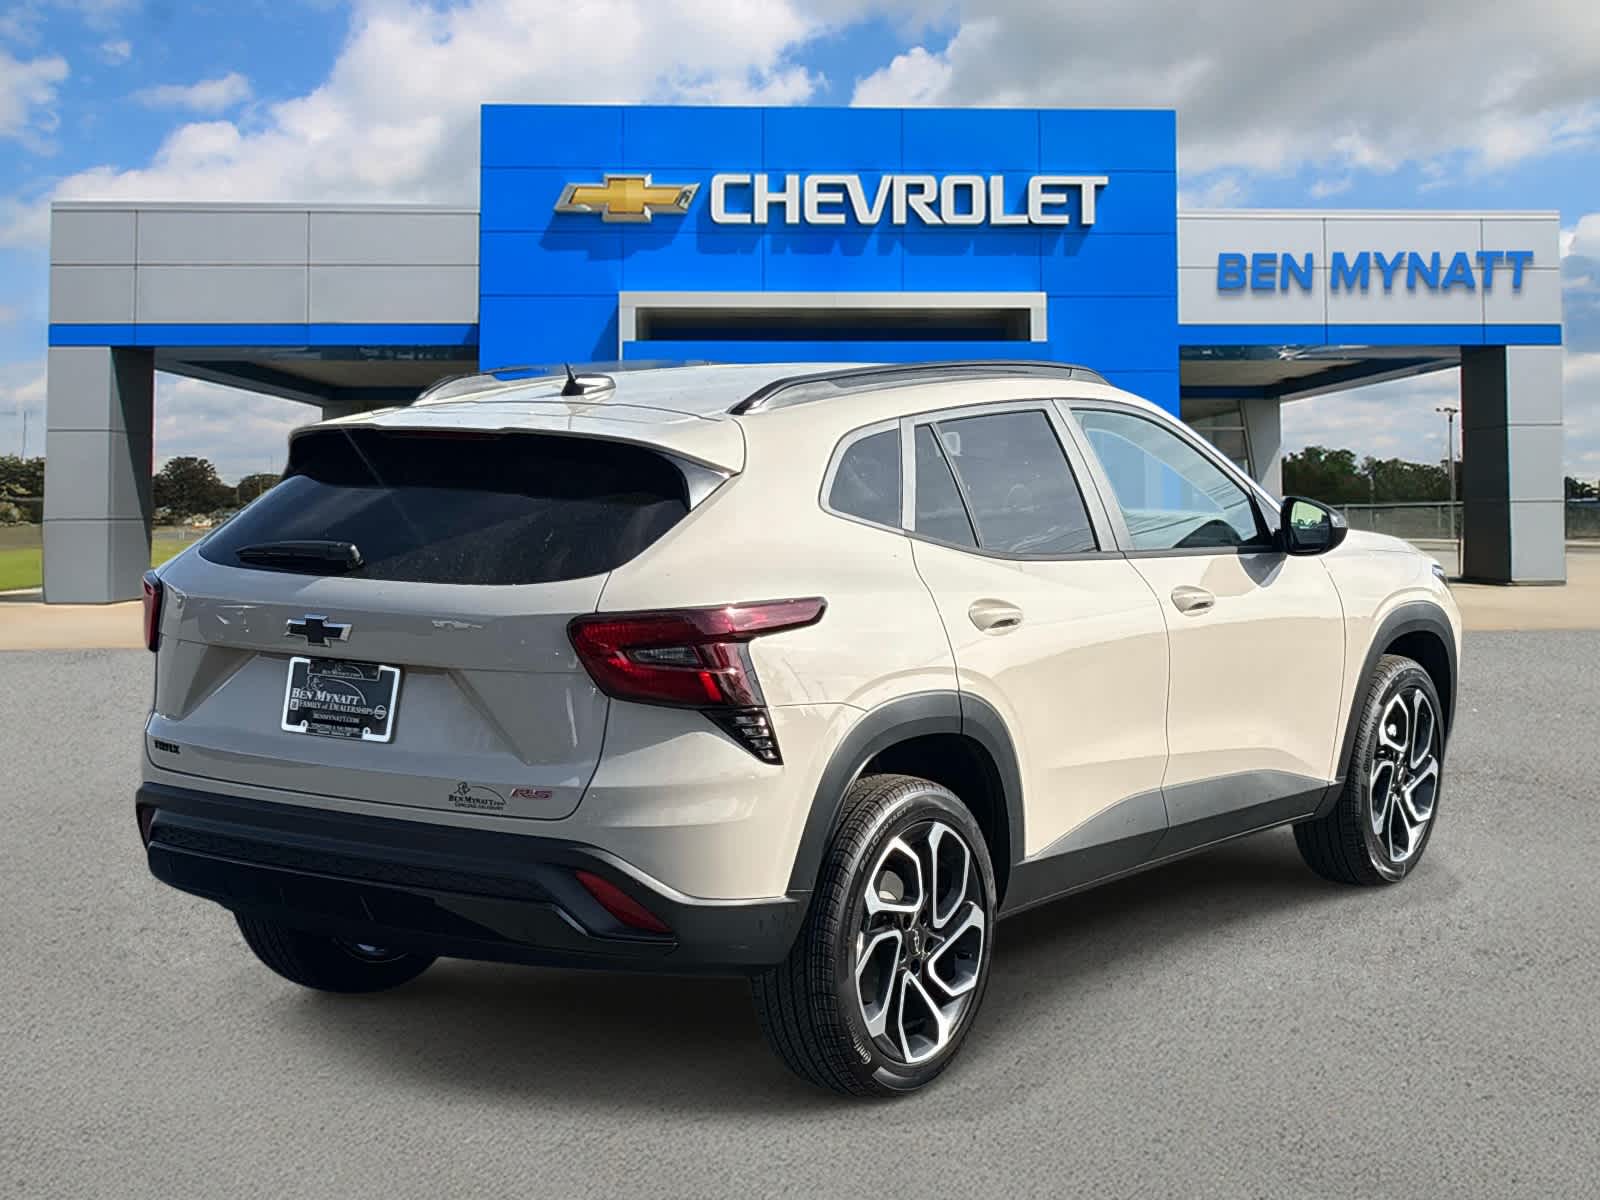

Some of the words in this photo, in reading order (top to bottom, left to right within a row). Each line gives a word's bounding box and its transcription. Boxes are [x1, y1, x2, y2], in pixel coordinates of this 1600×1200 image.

[710, 174, 1109, 226] CHEVROLET
[1217, 252, 1313, 290] BEN
[1330, 250, 1534, 290] MYNATT
[292, 688, 314, 700] BEN
[315, 690, 360, 705] MYNATT
